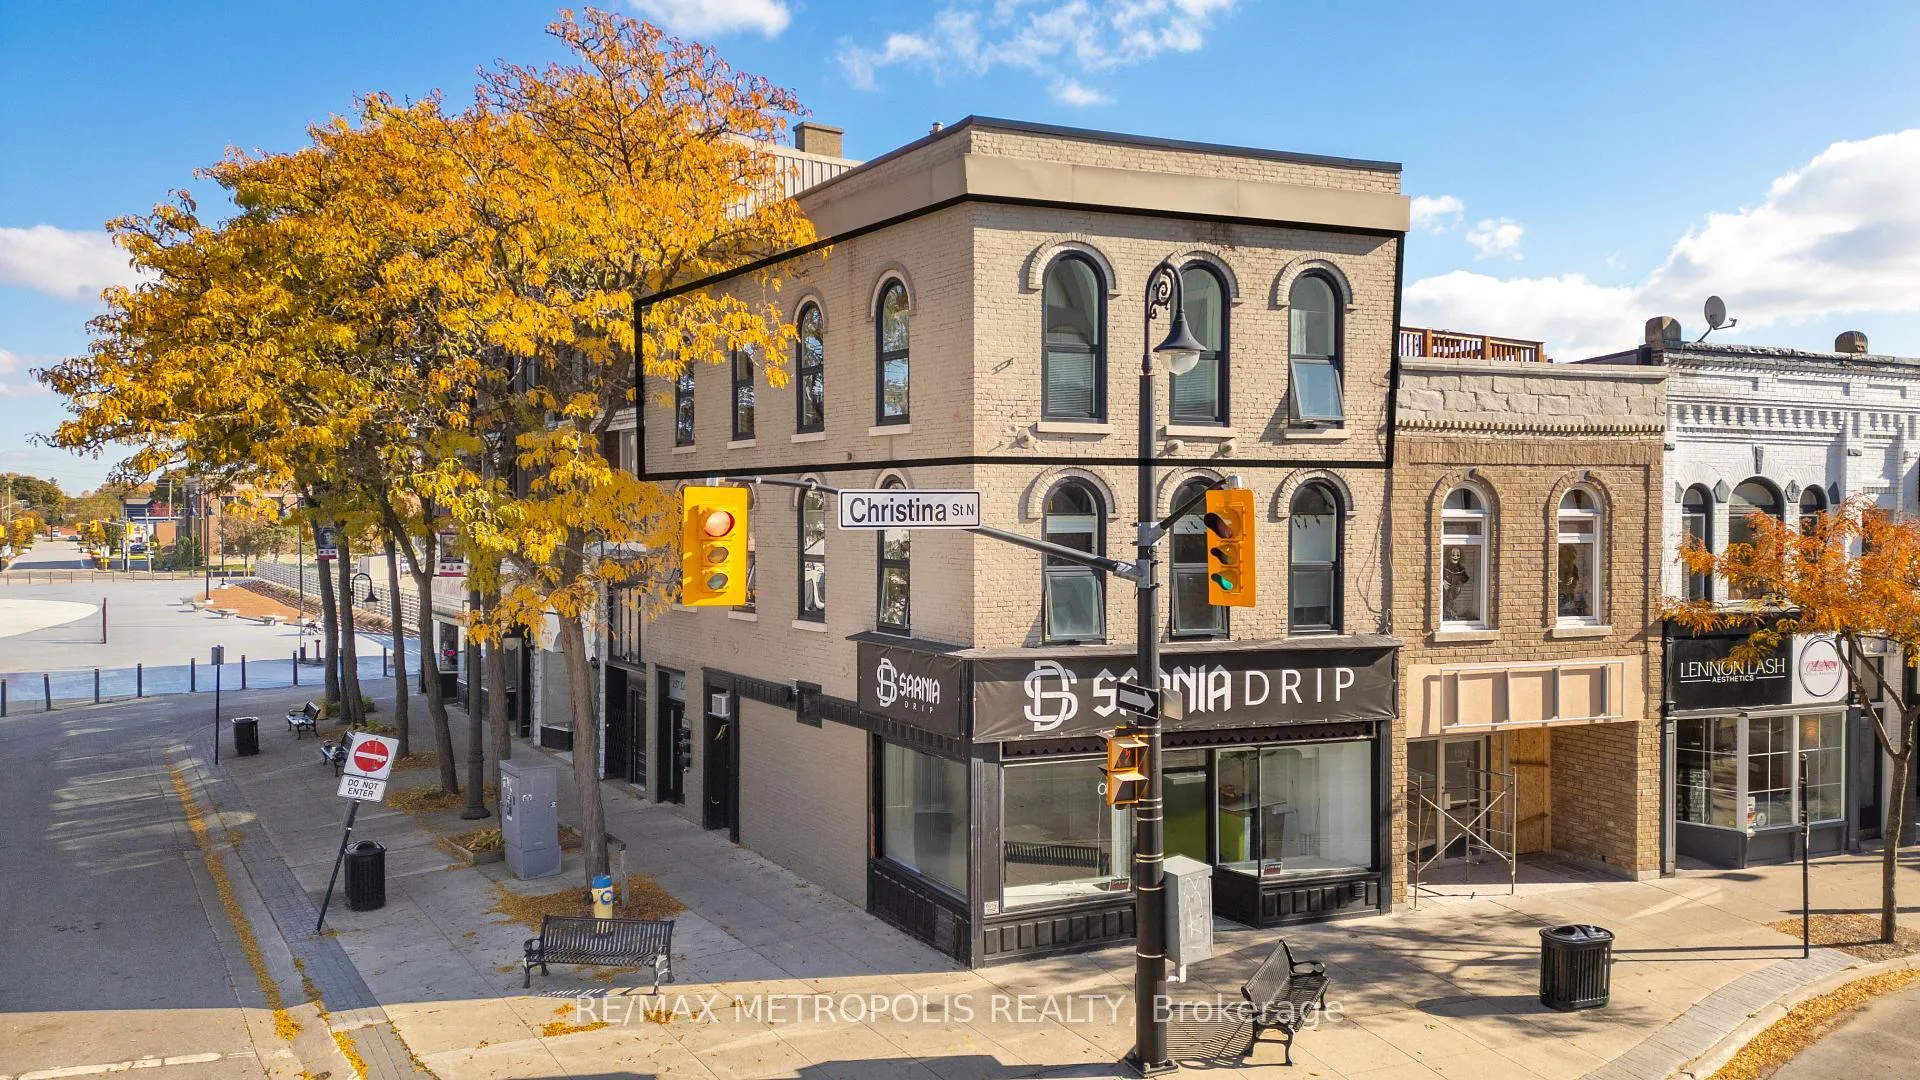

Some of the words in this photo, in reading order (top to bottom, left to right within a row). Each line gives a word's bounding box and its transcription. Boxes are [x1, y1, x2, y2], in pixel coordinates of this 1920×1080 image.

[850, 497, 947, 523] Christina
[952, 503, 963, 516] St
[966, 503, 975, 516] N
[1680, 660, 1745, 678] LENNON
[1746, 657, 1786, 676] LASH
[1244, 667, 1356, 706] DRIP
[1711, 674, 1755, 684] AESTHETICS
[900, 672, 941, 705] SARNIA
[904, 700, 934, 714] DRIP
[347, 779, 359, 787] DO
[362, 781, 379, 790] NOT
[347, 787, 374, 798] ENTER
